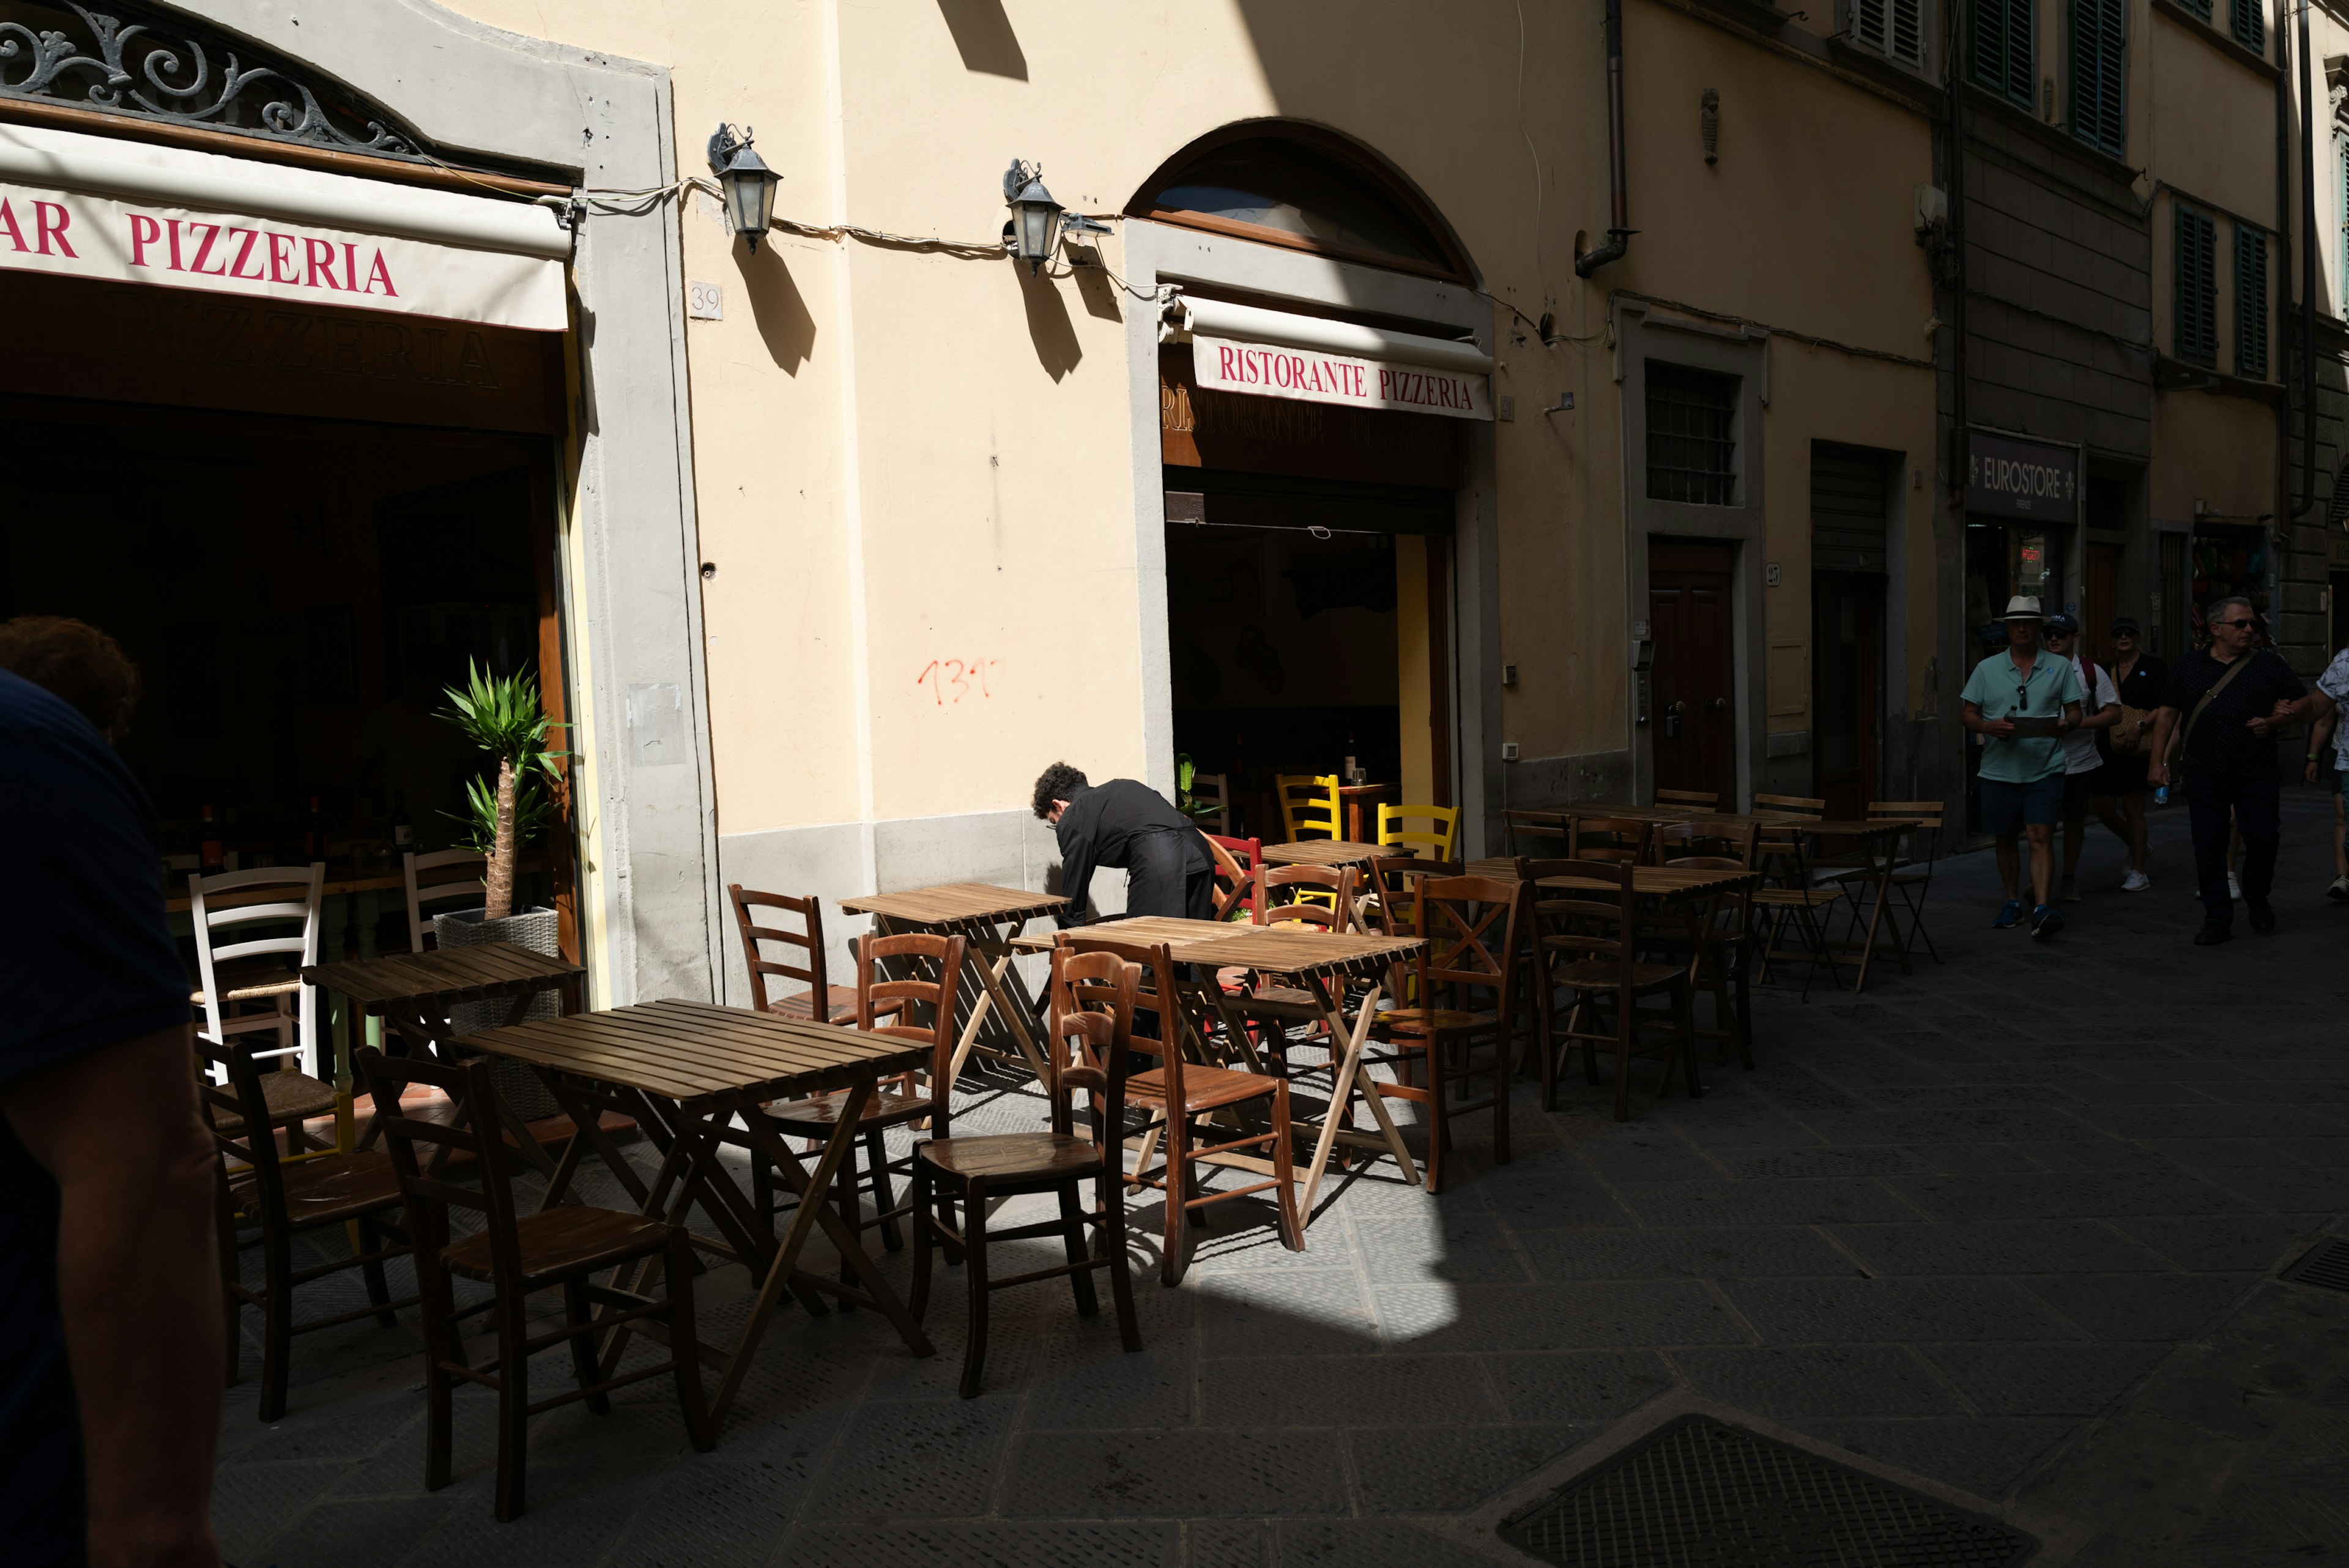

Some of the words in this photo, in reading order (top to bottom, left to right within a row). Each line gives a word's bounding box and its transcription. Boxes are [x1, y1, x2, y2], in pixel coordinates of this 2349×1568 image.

[125, 212, 399, 297] PIZZERIA
[691, 287, 719, 310] 39
[104, 289, 503, 391] PIZZERIA
[1218, 346, 1367, 398] RISTORANTE
[1378, 368, 1475, 411] PIZZERIA
[1161, 385, 1324, 445] RISTORANTE
[1349, 410, 1453, 459] PIERIA
[1502, 399, 1512, 417] 41
[1984, 456, 2060, 499] EUROSTORE
[2016, 499, 2032, 510] FIRENZE
[1768, 567, 1778, 583] 25
